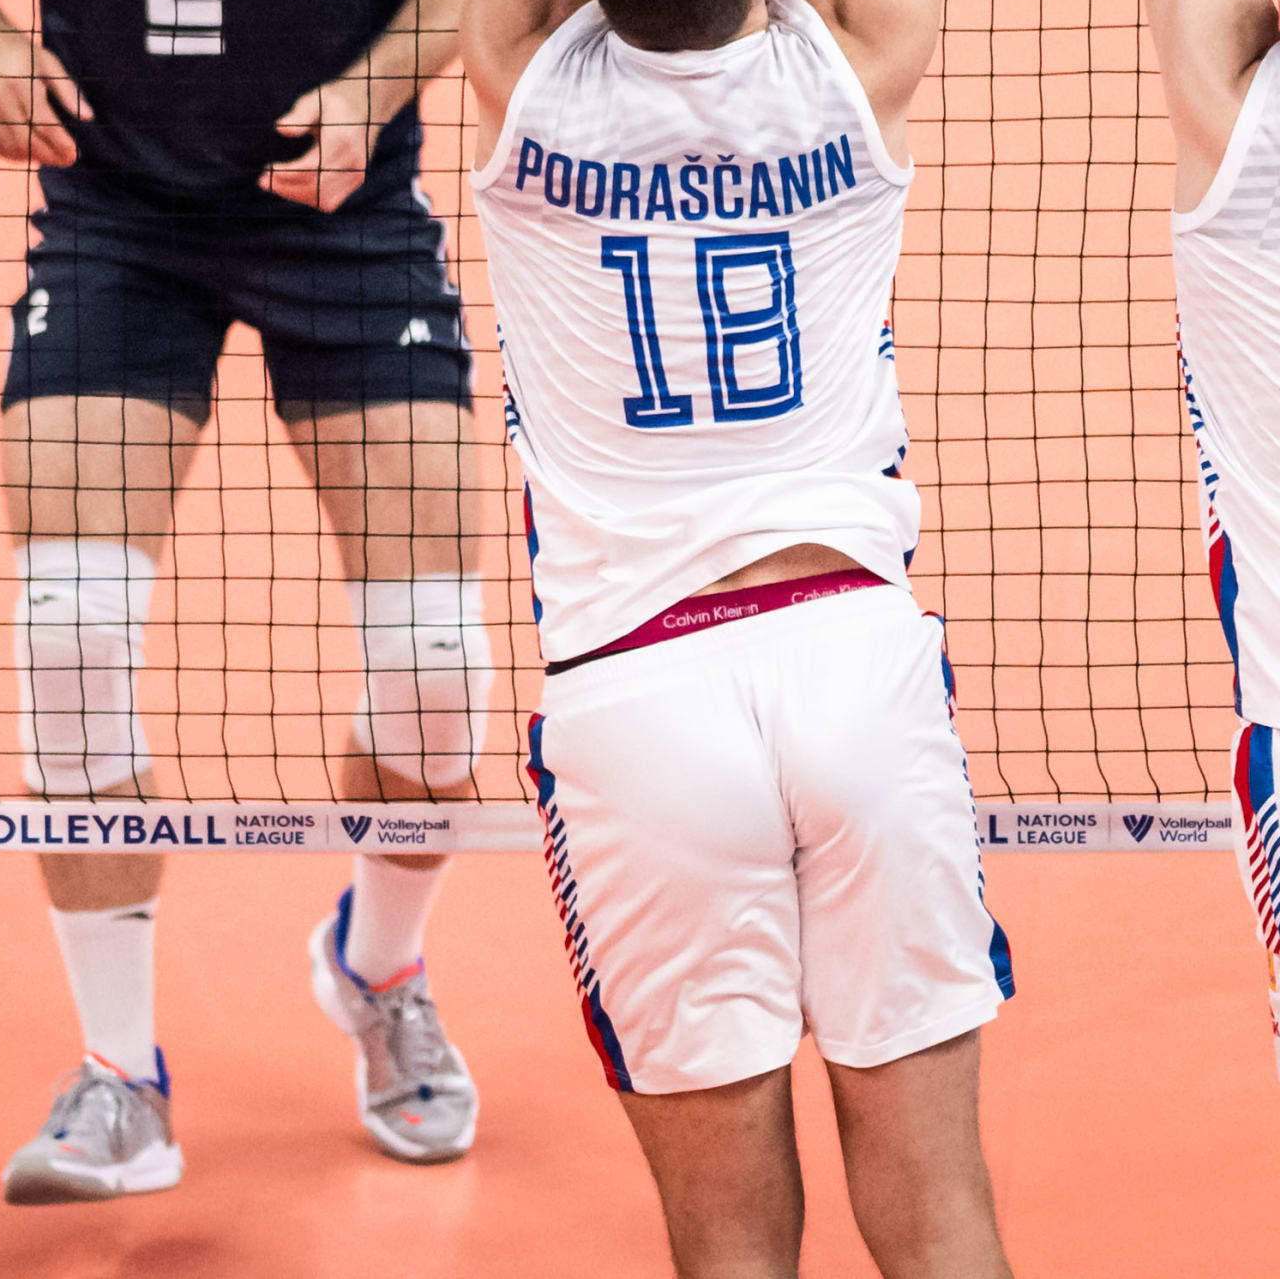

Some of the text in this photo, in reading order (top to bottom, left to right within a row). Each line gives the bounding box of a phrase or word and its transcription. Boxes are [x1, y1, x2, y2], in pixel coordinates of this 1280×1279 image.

[516, 133, 856, 221] PODRAŠČANIN
[601, 230, 804, 429] 18
[663, 608, 710, 630] Calvin
[235, 815, 315, 827] NATIONS
[377, 819, 450, 832] Volleyball
[1017, 814, 1097, 827] NATIONS
[1159, 817, 1232, 831] Volleyball
[235, 831, 305, 845] LEAGUE
[377, 831, 426, 844] World
[1017, 831, 1087, 844] LEAGUE
[1160, 830, 1208, 843] World
